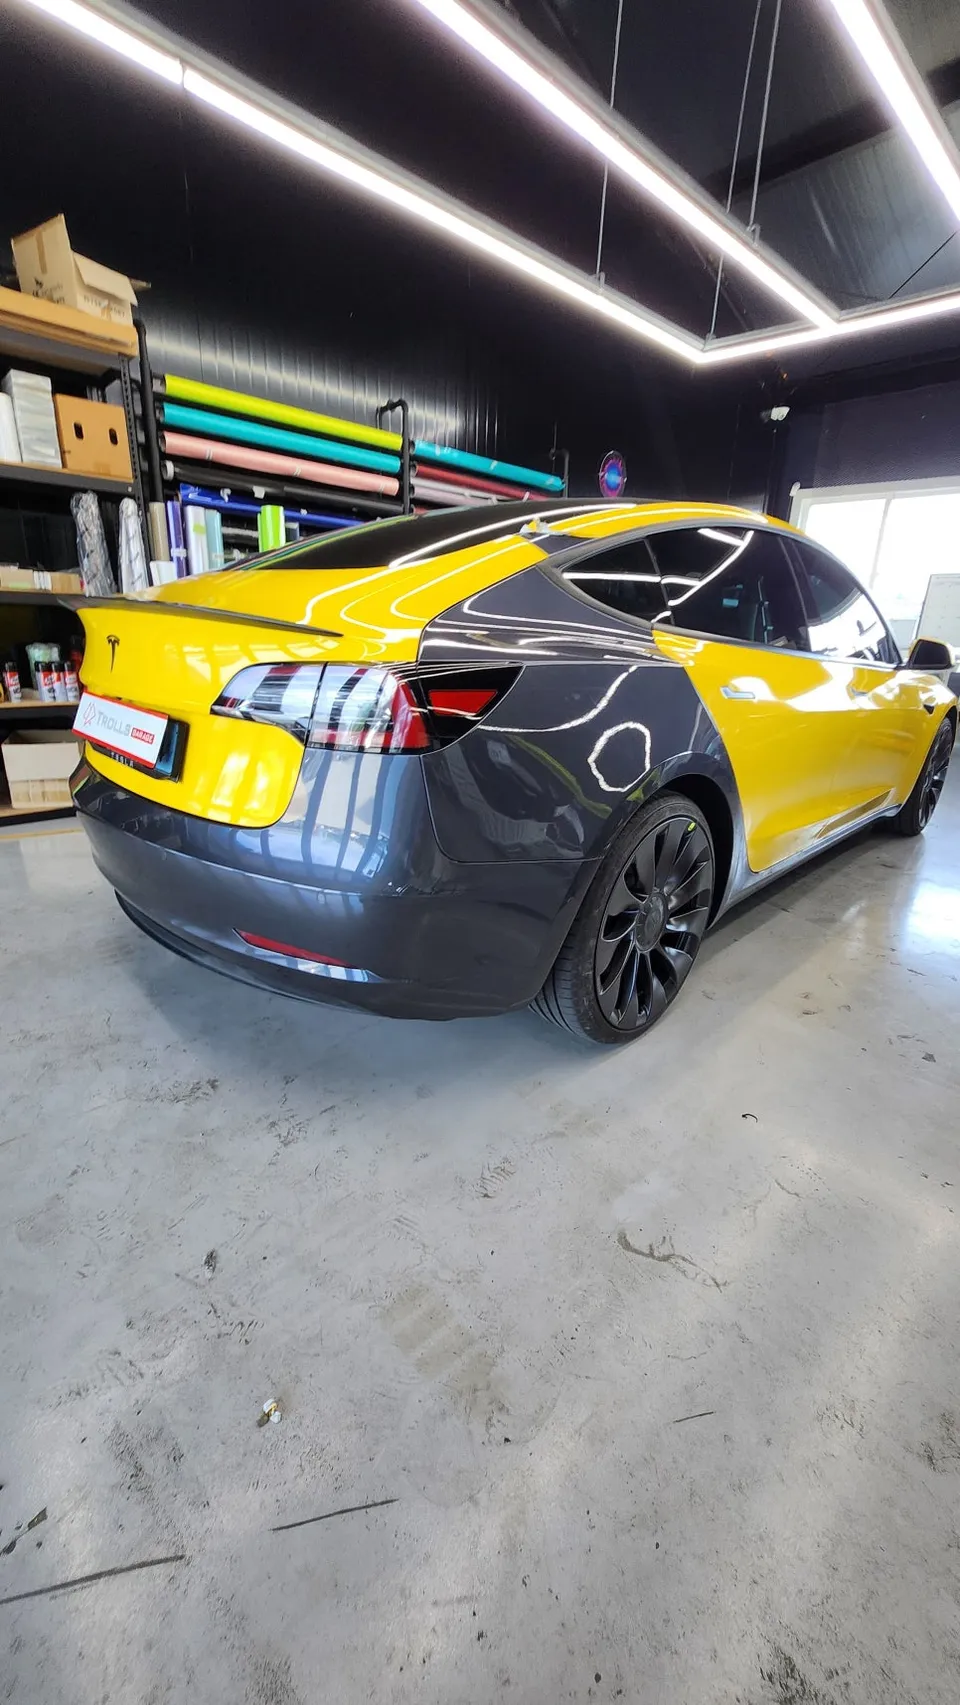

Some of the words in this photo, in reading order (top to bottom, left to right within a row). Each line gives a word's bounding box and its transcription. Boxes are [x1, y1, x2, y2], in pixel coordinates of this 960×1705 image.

[97, 711, 131, 736] TROLLS
[132, 729, 153, 743] GARAGE
[111, 752, 134, 767] TESLA
